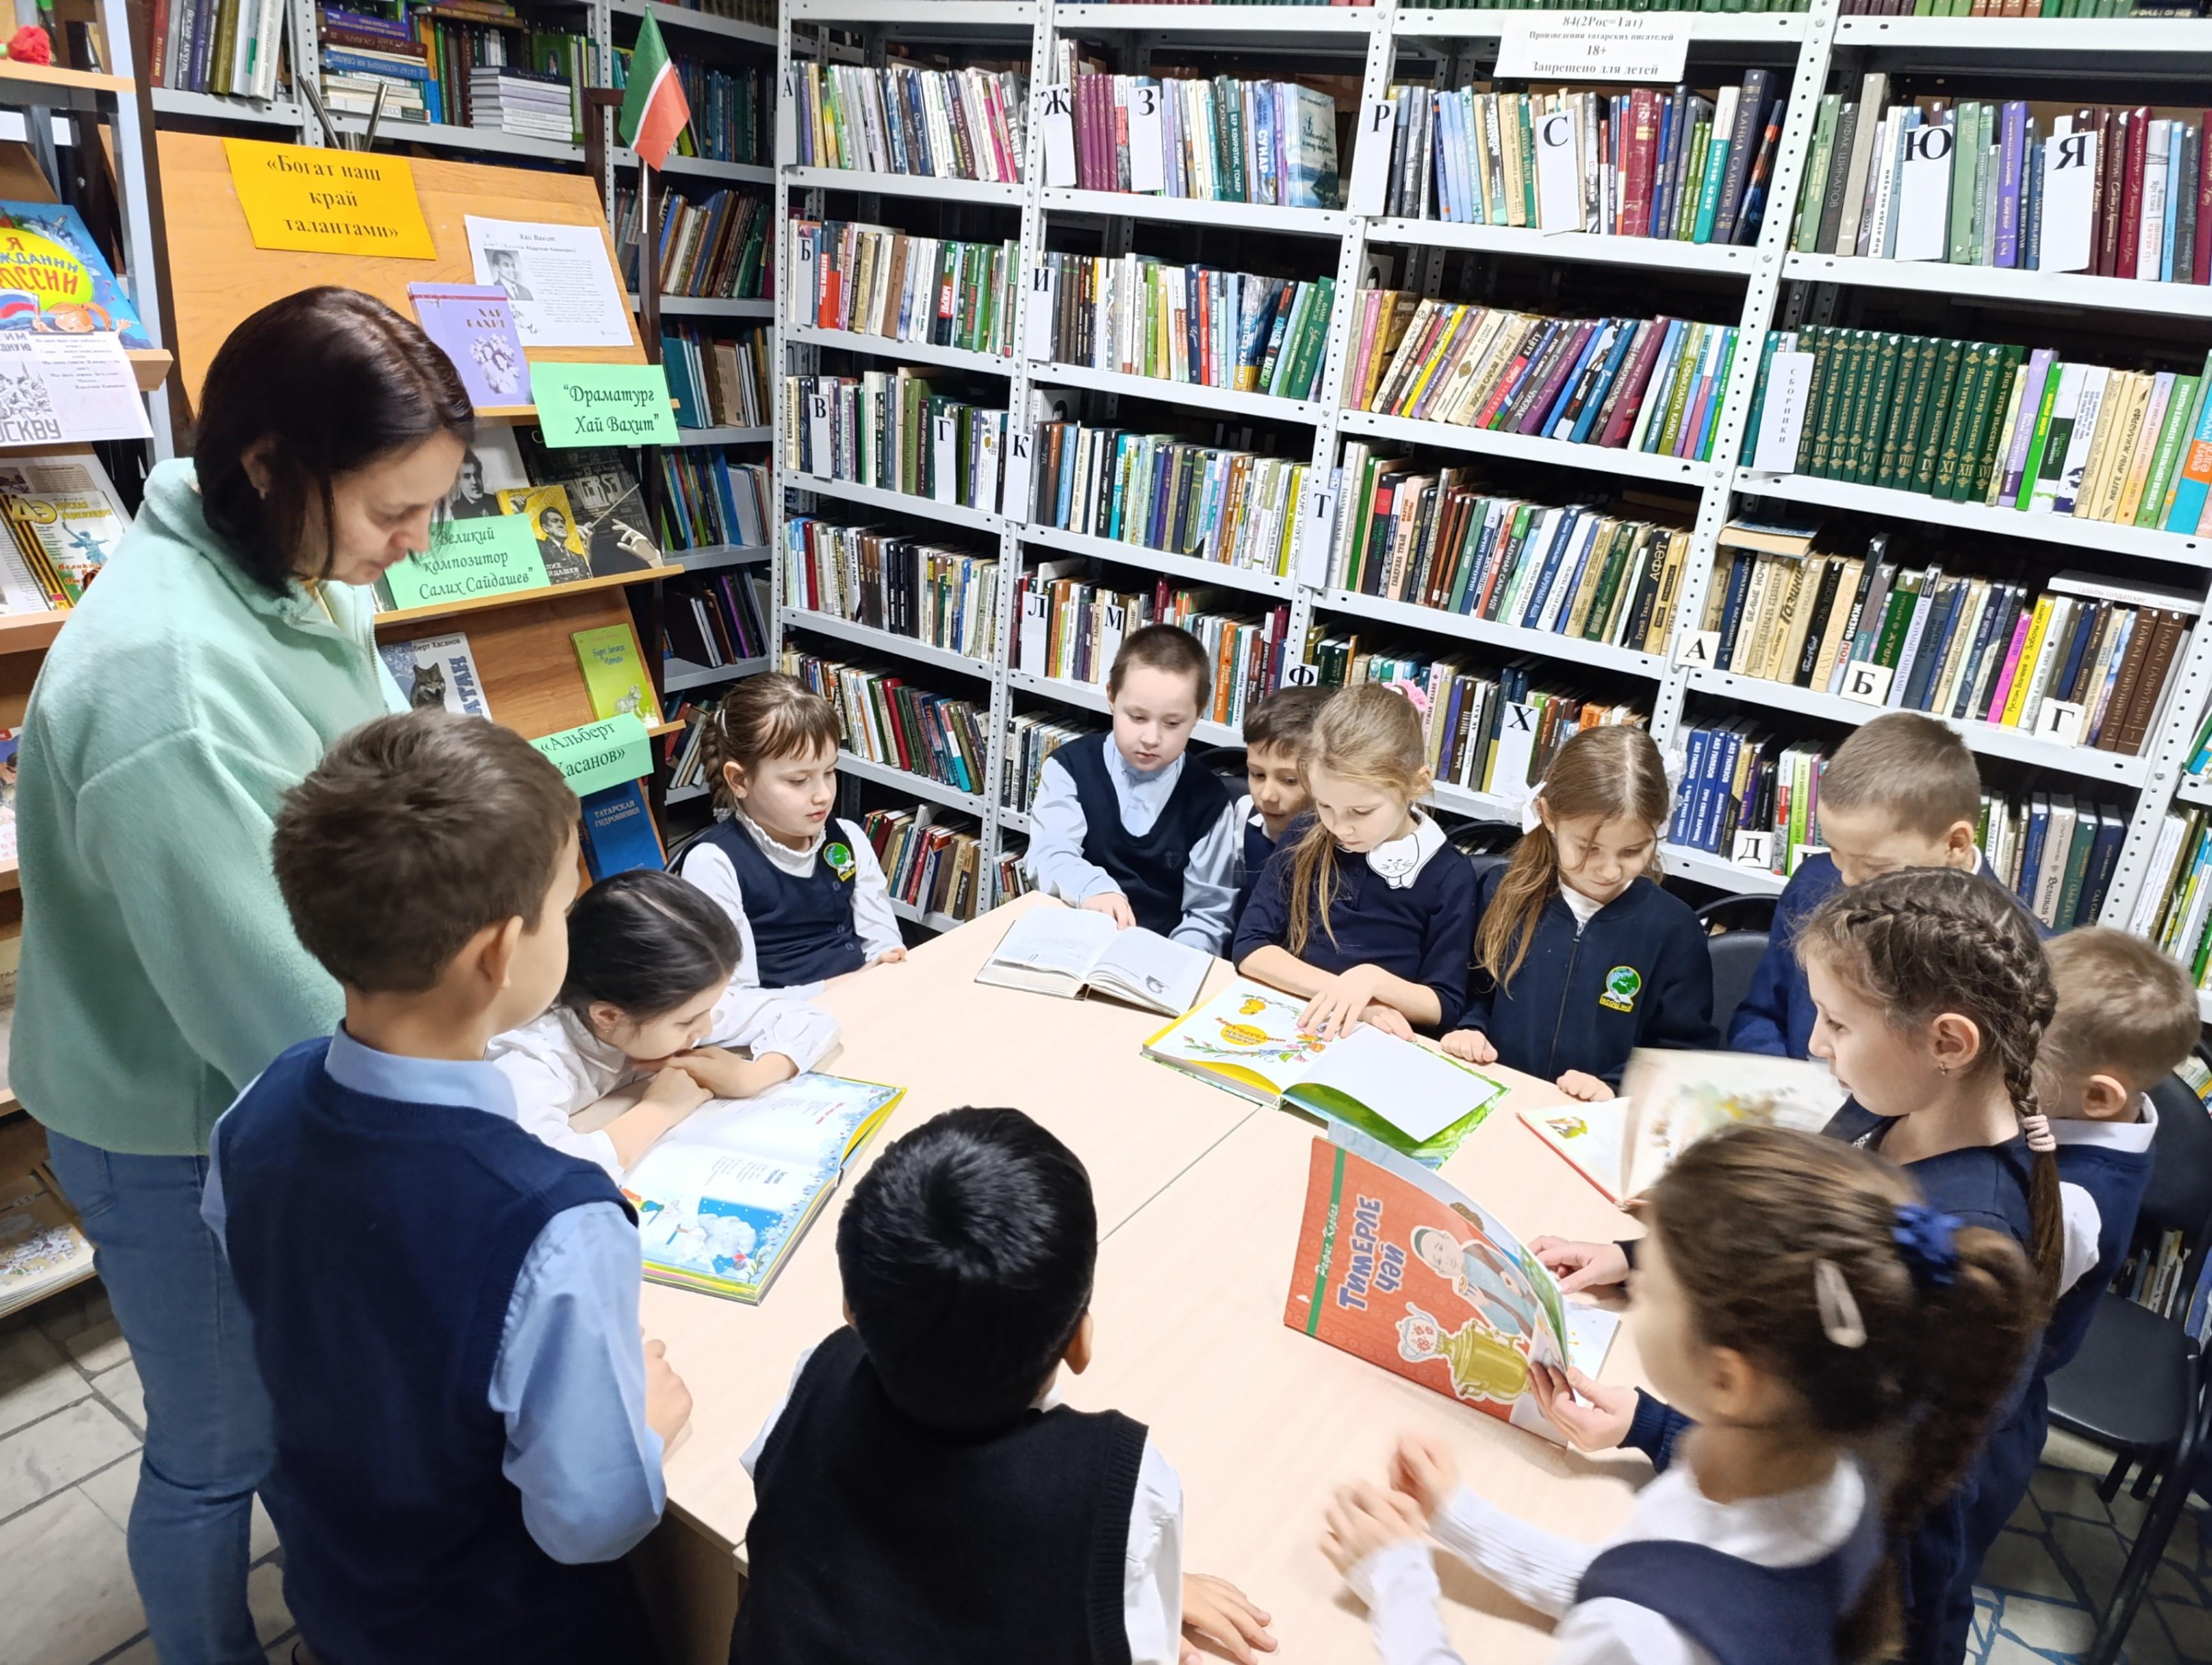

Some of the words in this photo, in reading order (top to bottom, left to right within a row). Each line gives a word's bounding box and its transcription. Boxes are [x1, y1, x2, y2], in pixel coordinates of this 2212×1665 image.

[1587, 45, 1607, 56] 18+
[1532, 61, 1596, 76] Запрещено
[1599, 65, 1621, 75] для
[1624, 64, 1659, 76] детей
[783, 79, 793, 97] А
[1041, 88, 1071, 116] Ж
[1138, 89, 1155, 116] З
[1371, 105, 1391, 133] Р
[1543, 115, 1569, 147] С
[1735, 110, 1749, 151] ДАНИЛ
[1840, 112, 1855, 149] ИЛФАК
[1258, 129, 1268, 174] СУНАР
[1902, 128, 1952, 162] Ю
[2054, 135, 2090, 170] Я
[267, 155, 334, 178] «Богат
[341, 164, 382, 181] наш
[1829, 152, 1846, 208] ШИҺАПОВ
[1722, 156, 1740, 207] САЛИХОВ
[310, 190, 358, 209] край
[282, 217, 400, 239] талантами»
[1862, 208, 1872, 234] ЙОЗАК
[7, 237, 25, 251] Я
[801, 239, 811, 261] Б
[0, 253, 78, 273] ЖДАНИН
[0, 266, 79, 296] ОССИИ
[1034, 267, 1050, 292] И
[1241, 310, 1252, 349] БӘХЕТСЕЗ
[1523, 331, 1542, 357] КАЙТУ
[1237, 351, 1247, 384] ҖАННАР
[1673, 360, 1694, 410] ОФЫКЛАРГА
[1827, 372, 1839, 395] татар
[1875, 379, 1886, 402] татар
[815, 398, 827, 418] В
[1514, 389, 1539, 419] ЧУКРАК
[1957, 386, 1969, 409] татар
[1976, 389, 1989, 412] татар
[1994, 391, 2008, 415] татар
[575, 414, 603, 434] Хай
[1822, 398, 1834, 430] пьесасы
[1869, 403, 1881, 437] пьесасы
[938, 421, 951, 441] Г
[1950, 411, 1964, 446] пьесасы
[1968, 414, 1983, 449] пьесасы
[1987, 418, 2002, 451] пьесасы
[1012, 434, 1029, 458] К
[2146, 483, 2163, 510] АНТОЛОГИЯ
[2174, 384, 2190, 413] РАССКАЗА
[1314, 493, 1332, 518] Т
[1396, 533, 1408, 554] ТУКАЙ
[1478, 528, 1491, 553] КӘРИМ
[424, 553, 509, 575] композитор
[1500, 538, 1517, 573] КАЕННАР
[1648, 541, 1668, 581] АФӘТ
[1391, 555, 1405, 587] ГАБДУЛЛА
[1468, 554, 1485, 592] ТИНЧУРИН
[1493, 573, 1507, 595] САРЫ
[419, 581, 467, 600] Салих
[1534, 571, 1553, 603] КАРУРМАН
[1028, 597, 1046, 619] Л
[1106, 606, 1122, 631] М
[1745, 590, 1760, 622] БЕЛЫЕ
[1905, 599, 1929, 652] ОДЕРЖИМЫЙ
[432, 637, 460, 649] Хасанов
[1685, 638, 1709, 661] А
[2025, 627, 2040, 651] Заботы
[2132, 623, 2152, 659] ТАЛГАТ
[2153, 628, 2174, 662] ТАЛГАТ
[1289, 665, 1314, 686] Ф
[1849, 671, 1877, 697] Б
[1893, 652, 1915, 691] ТАНЦАМИ
[2014, 663, 2030, 688] Валеев
[448, 655, 481, 718] АТАН
[2110, 662, 2141, 720] ГАЛИУЛЛИН
[2132, 665, 2162, 725] ГАЛИУЛЛИН
[1472, 704, 1481, 719] КАЗ
[2006, 689, 2023, 712] Рустам
[1471, 721, 1478, 732] АК
[1507, 705, 1531, 732] Х
[2050, 711, 2074, 735] Г
[541, 723, 617, 753] «Альберт
[1694, 741, 1702, 753] АЯЗ
[1713, 737, 1722, 750] АЯЗ
[1728, 741, 1736, 754] АЯЗ
[1688, 753, 1699, 780] ГИЛЯЗОВ
[1706, 751, 1719, 779] ГИЛЯЗОВ
[1721, 755, 1734, 783] ГИЛЯЗОВ
[1702, 788, 1710, 801] ПРИ
[594, 800, 635, 819] ТАТАРСКАЯ
[1698, 802, 1706, 818] СВЕТЕ
[1692, 818, 1703, 842] ЗАРНИЦ
[1738, 838, 1764, 866] Д
